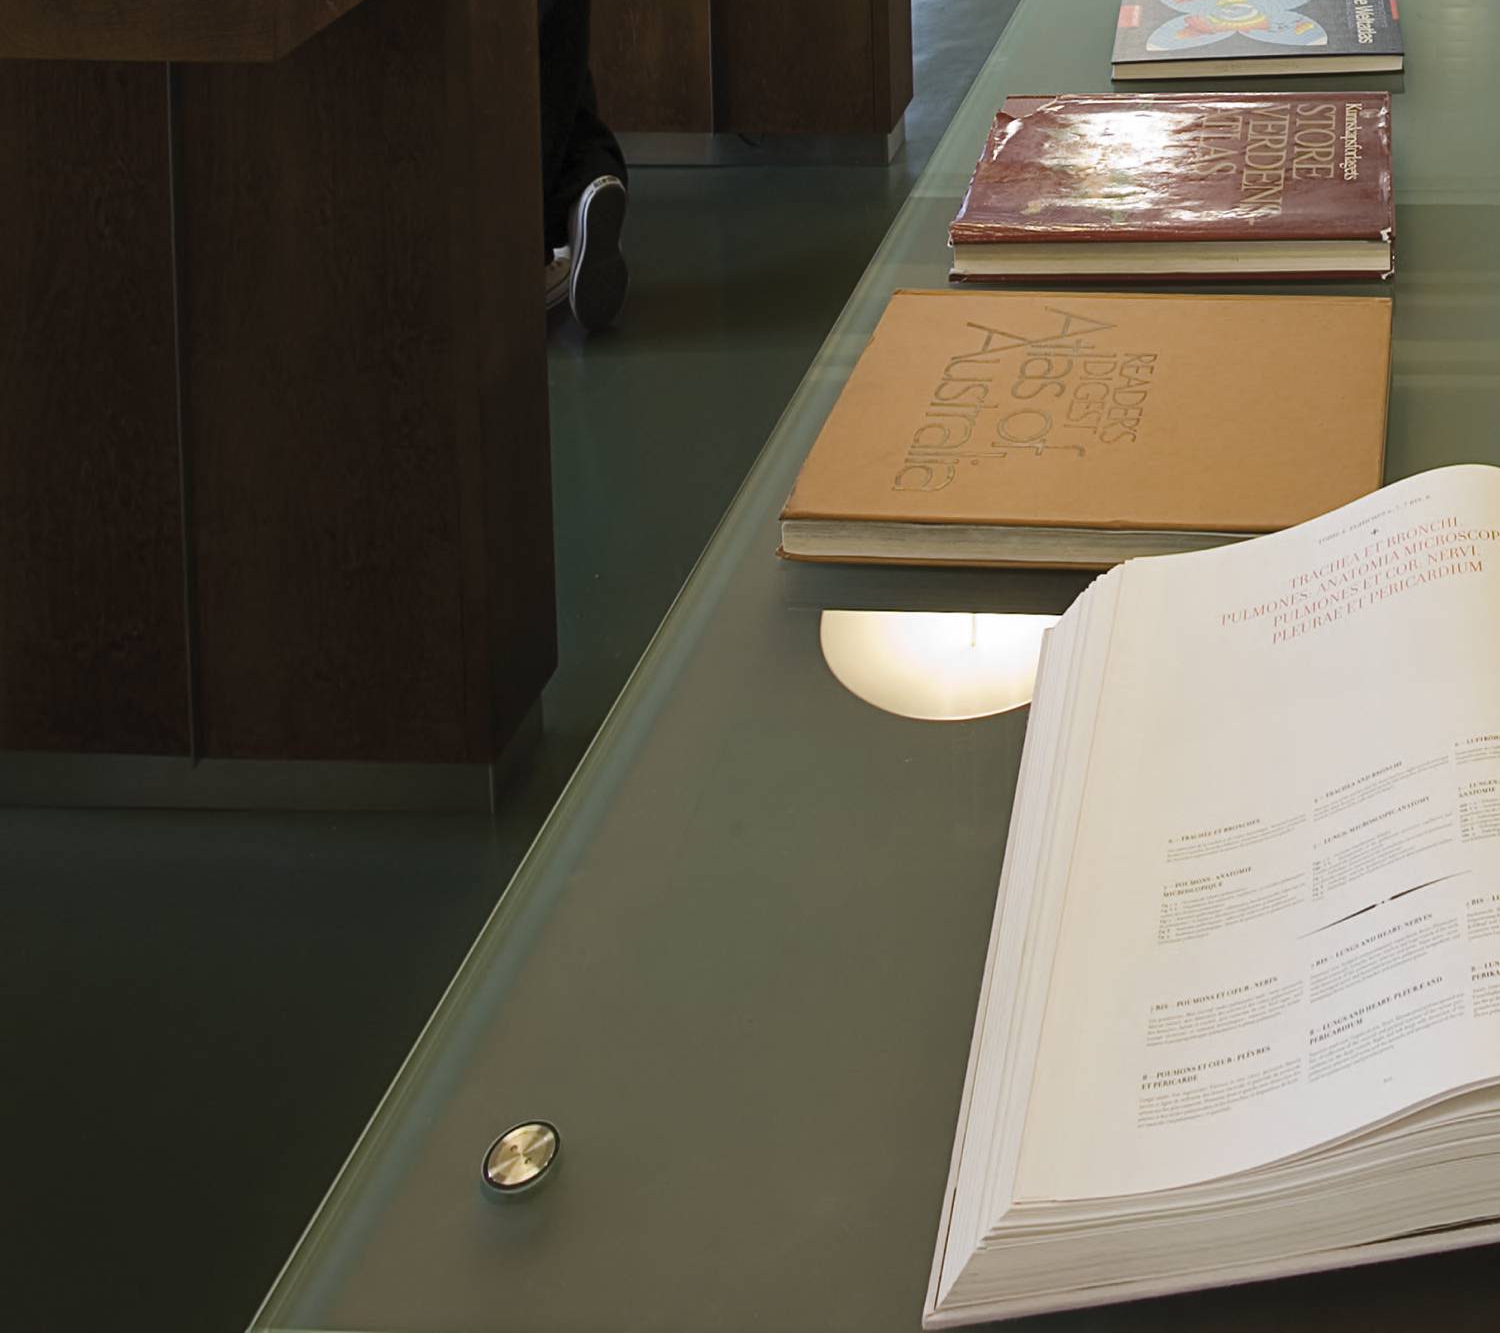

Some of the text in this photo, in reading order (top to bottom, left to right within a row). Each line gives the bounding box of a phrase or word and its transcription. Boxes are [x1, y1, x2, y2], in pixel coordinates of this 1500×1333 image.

[1354, 5, 1373, 44] Weltatlas
[1198, 107, 1243, 178] ATLAS
[1292, 103, 1337, 180] STORE
[1343, 102, 1364, 181] Kunnskapsforlagets
[891, 321, 1035, 493] Australia
[991, 304, 1118, 459] Atlas of
[1061, 353, 1119, 436] DIGEST
[1272, 583, 1360, 628] PULMONES
[1361, 575, 1381, 591] ET
[1272, 560, 1484, 645] PLEURAE ET PERICARDIUM
[1288, 551, 1361, 589] TRACHEA
[1363, 544, 1383, 559] ET
[1317, 552, 1400, 593] ANATOMIA
